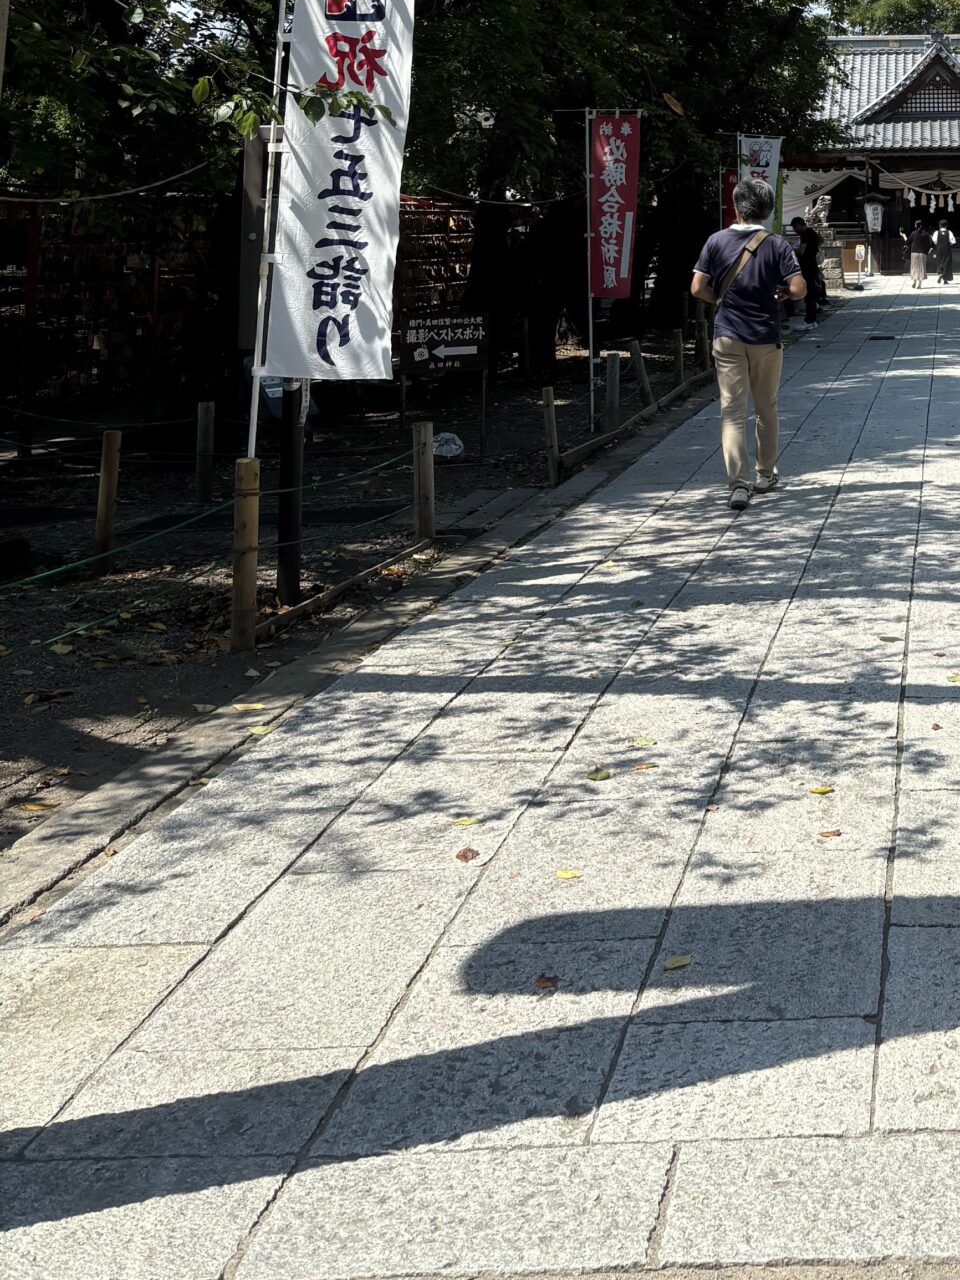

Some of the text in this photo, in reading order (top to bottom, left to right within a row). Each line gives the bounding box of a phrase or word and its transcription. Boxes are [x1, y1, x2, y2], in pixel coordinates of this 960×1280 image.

[406, 325, 486, 344] 撮影ベストスポット
